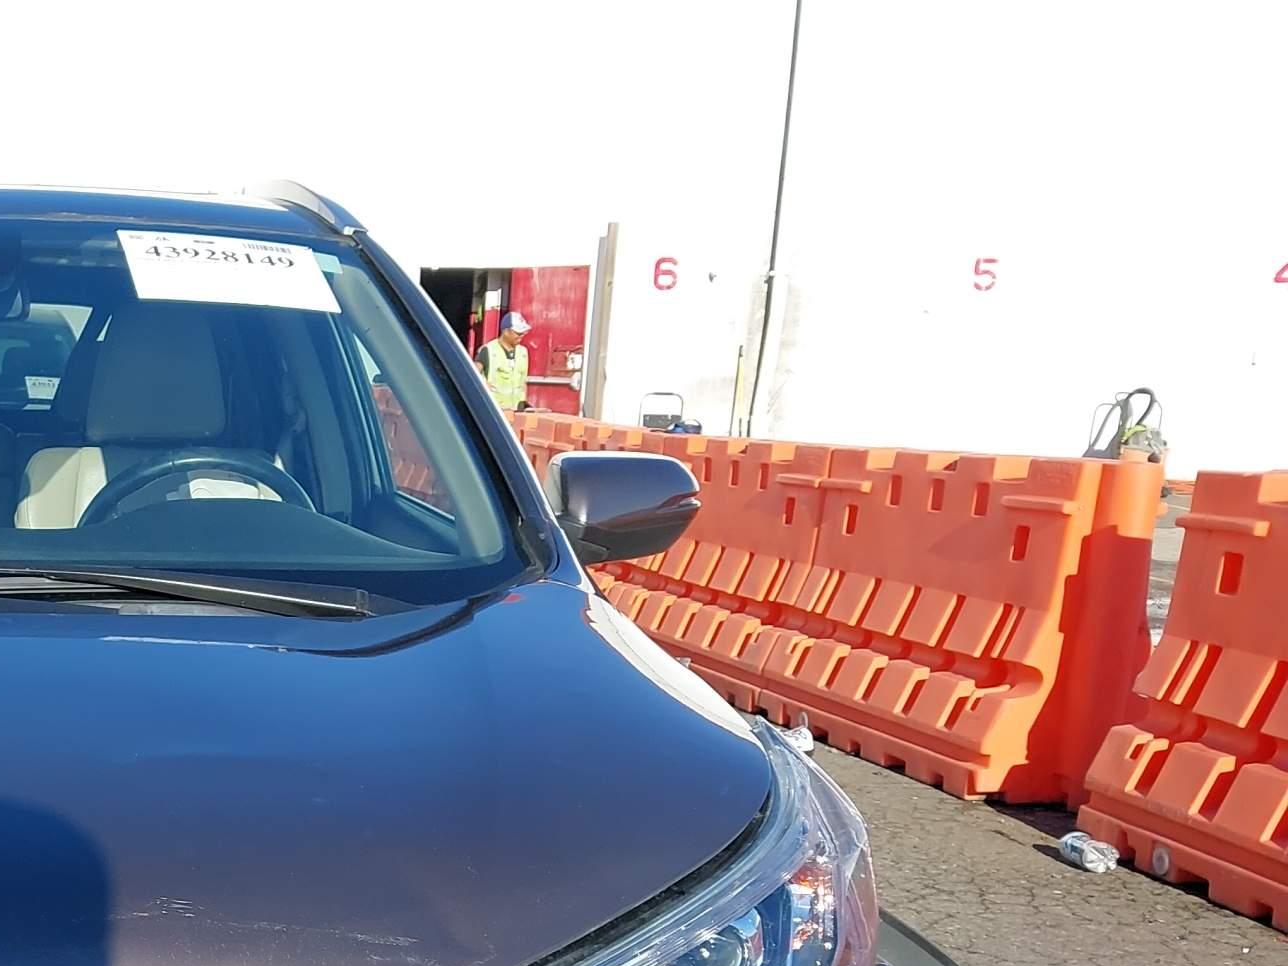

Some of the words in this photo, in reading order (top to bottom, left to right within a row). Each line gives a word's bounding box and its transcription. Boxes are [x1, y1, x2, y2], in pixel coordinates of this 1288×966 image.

[144, 245, 295, 269] 43928149
[653, 256, 677, 290] 6
[974, 257, 999, 291] 5
